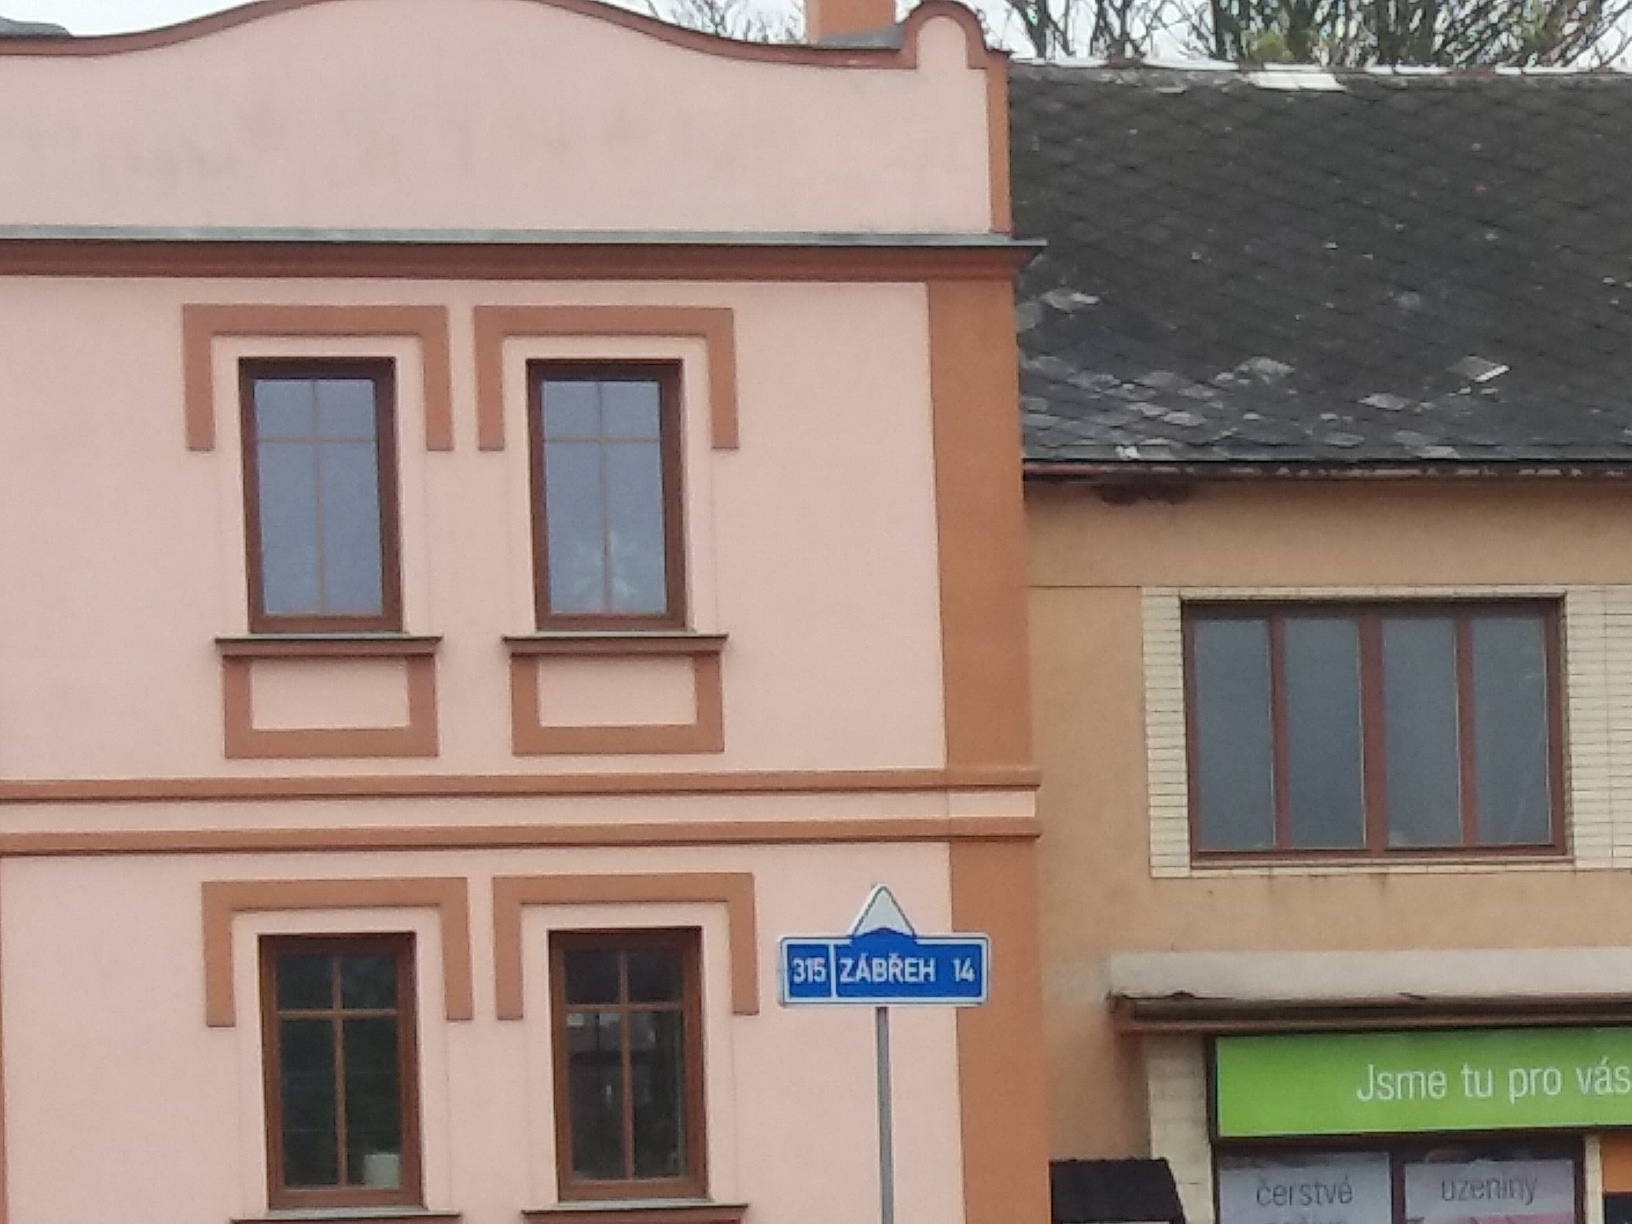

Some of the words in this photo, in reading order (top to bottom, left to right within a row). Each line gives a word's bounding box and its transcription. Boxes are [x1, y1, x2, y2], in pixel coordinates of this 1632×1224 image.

[792, 957, 827, 984] 315
[839, 951, 936, 983] ZÁBŘEH
[953, 957, 975, 983] 14
[1356, 1064, 1446, 1101] Jsme
[1461, 1062, 1493, 1098] tu
[1509, 1066, 1562, 1104] pro
[1576, 1057, 1632, 1095] vás
[1256, 1176, 1353, 1206] čerstvé
[1442, 1173, 1538, 1205] uzeniny
